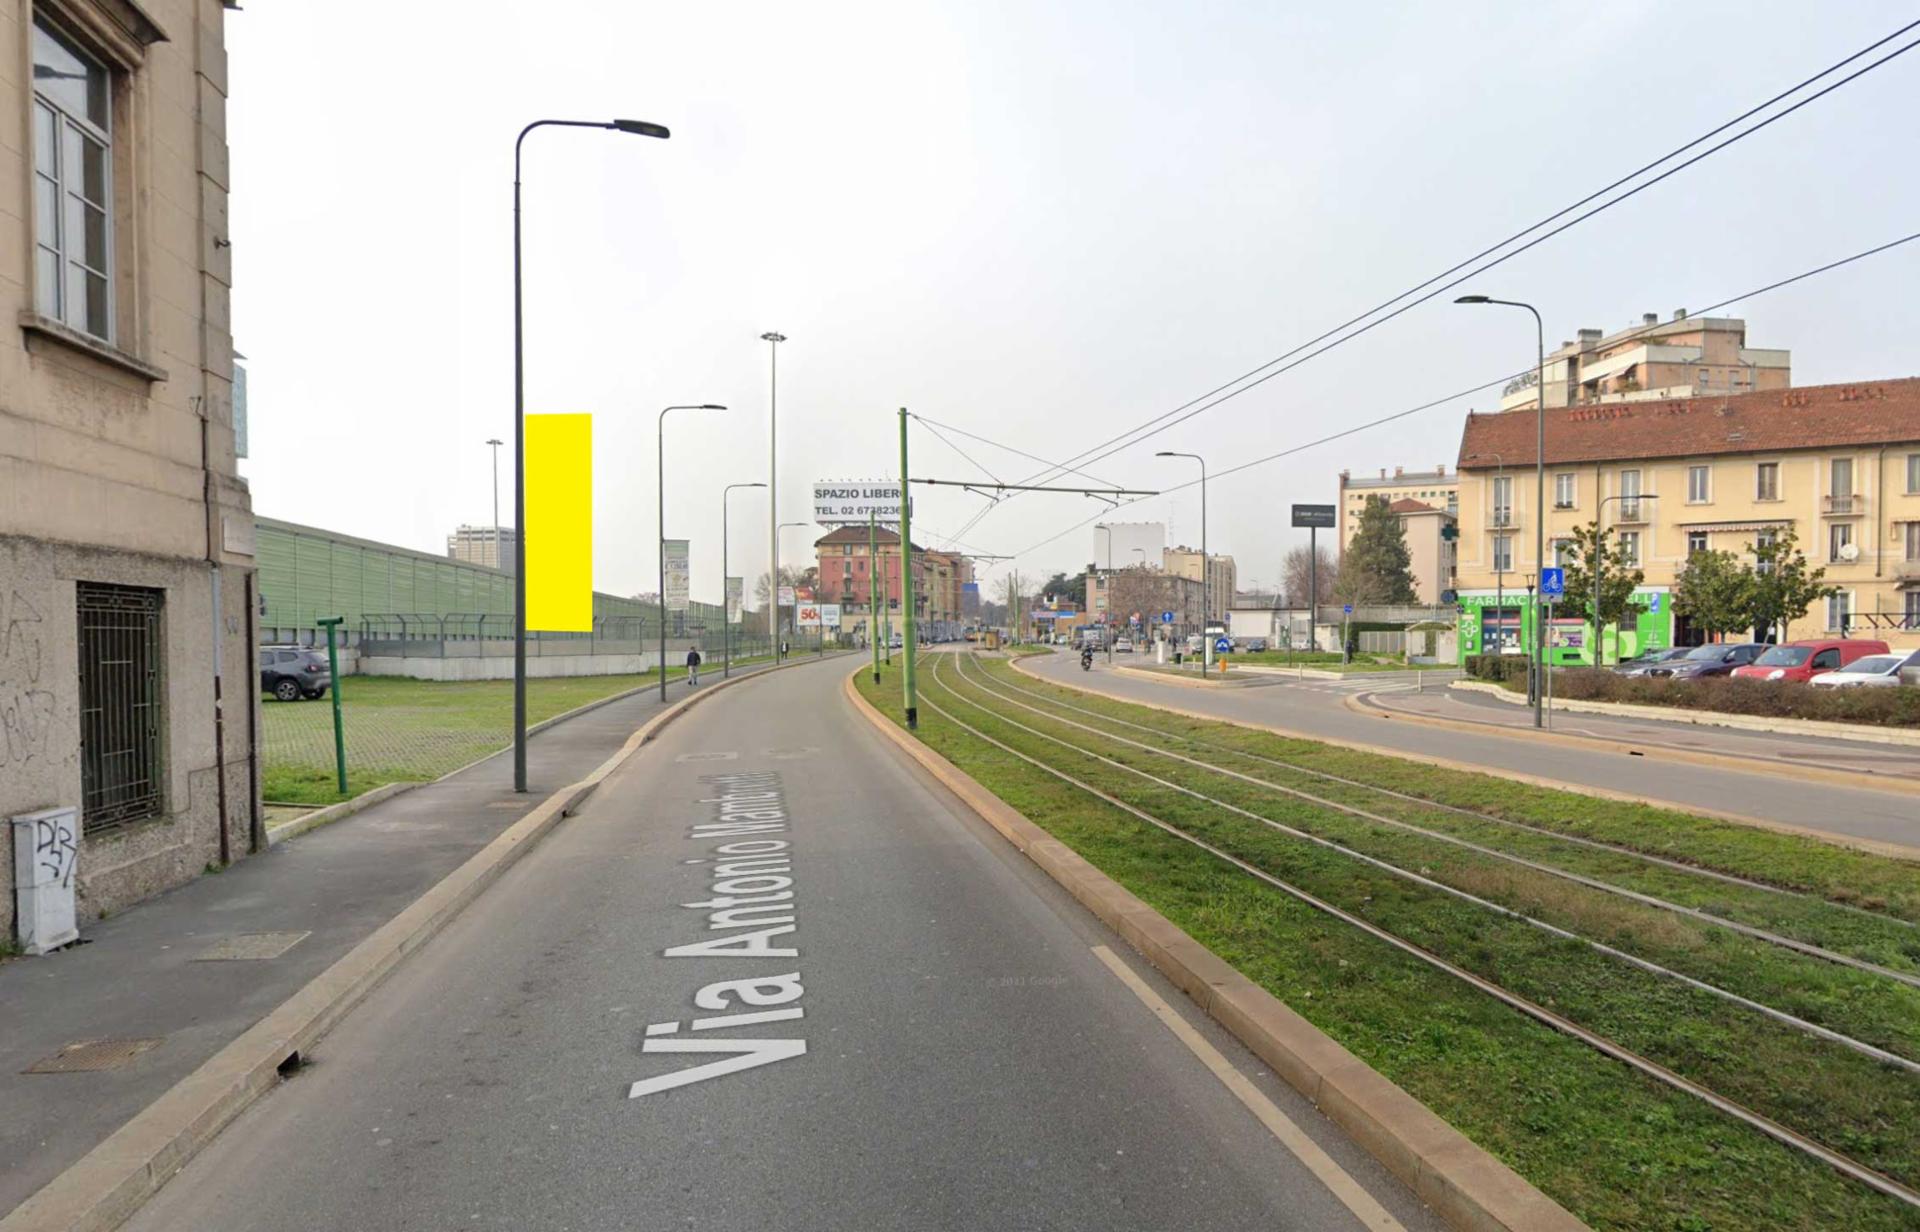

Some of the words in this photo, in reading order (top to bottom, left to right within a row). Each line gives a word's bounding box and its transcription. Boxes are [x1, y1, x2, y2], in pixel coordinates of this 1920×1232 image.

[815, 489, 860, 499] SPAZIO
[863, 489, 902, 499] LIBER
[815, 506, 838, 515] TEL.
[841, 506, 854, 515] 02
